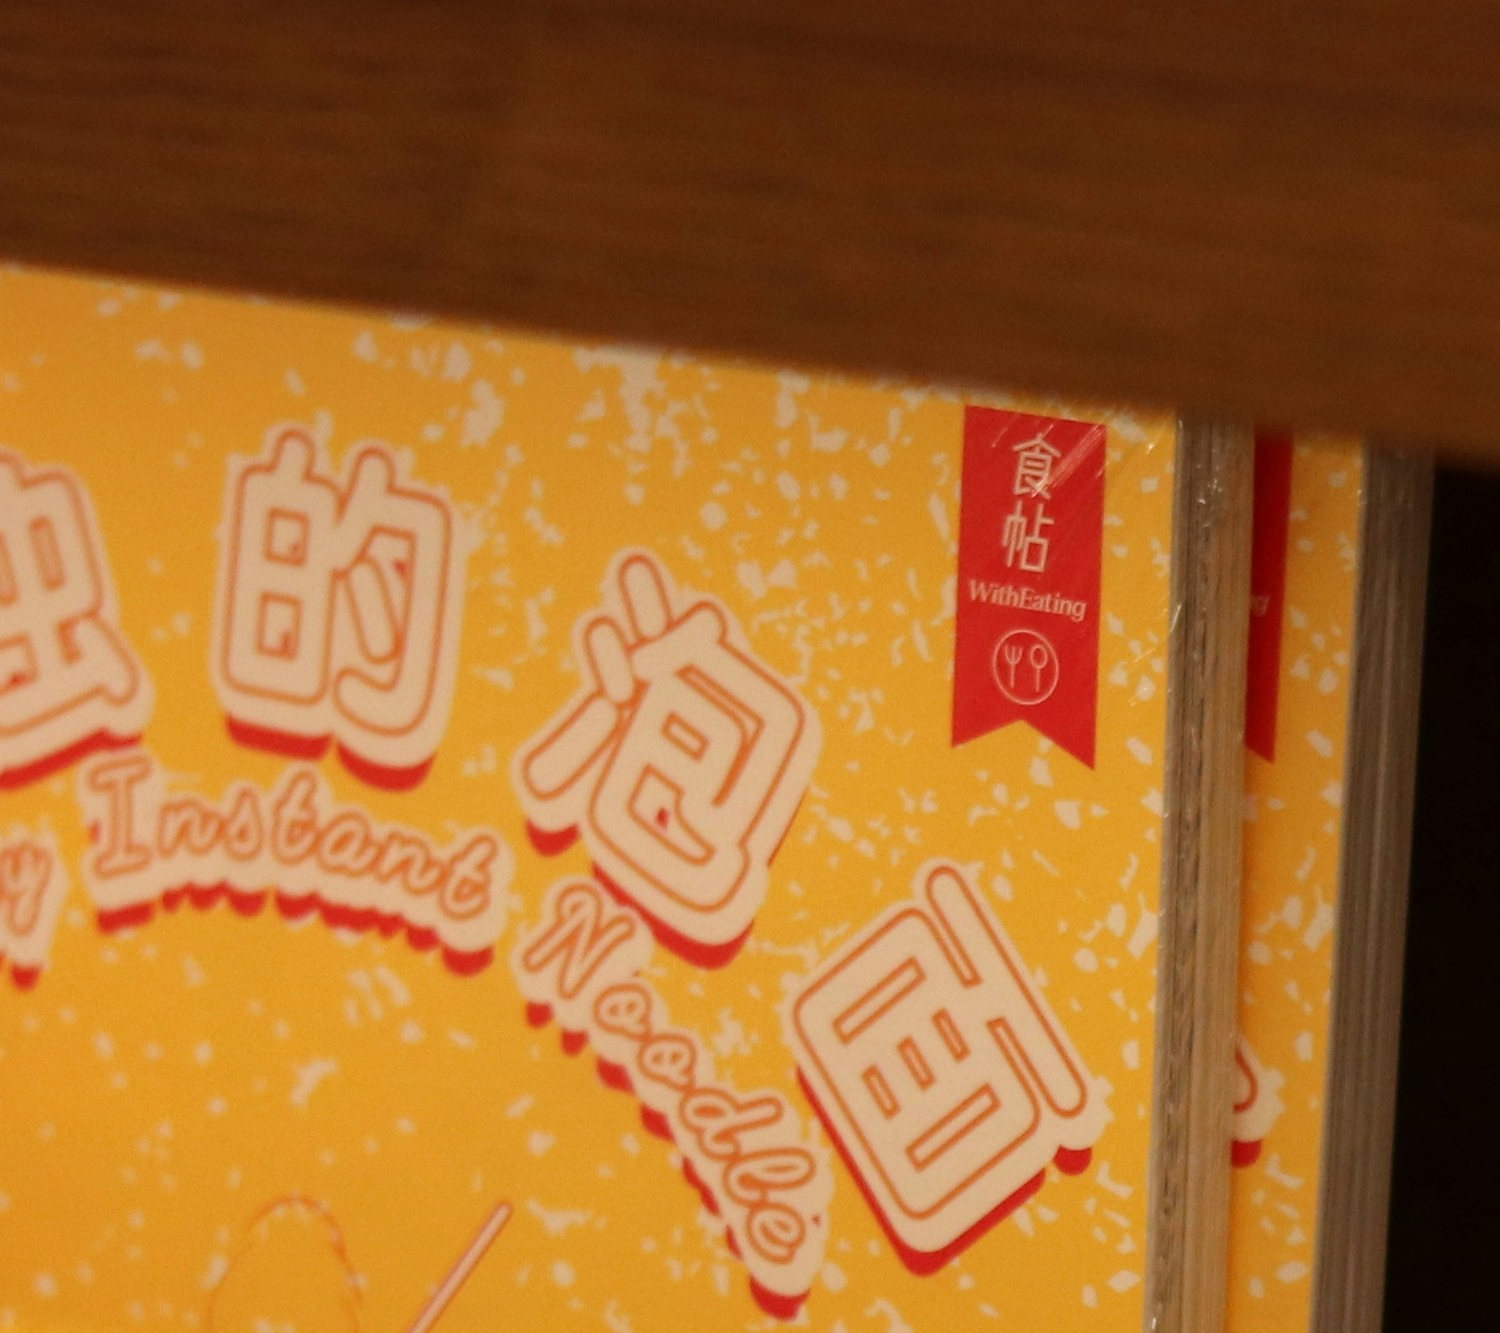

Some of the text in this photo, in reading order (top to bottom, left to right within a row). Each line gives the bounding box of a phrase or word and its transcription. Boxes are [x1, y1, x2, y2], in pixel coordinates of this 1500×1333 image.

[1000, 431, 1062, 576] 食帖
[968, 577, 1087, 624] WithEating
[77, 745, 512, 978] Instant
[512, 871, 832, 1320] Noodle
